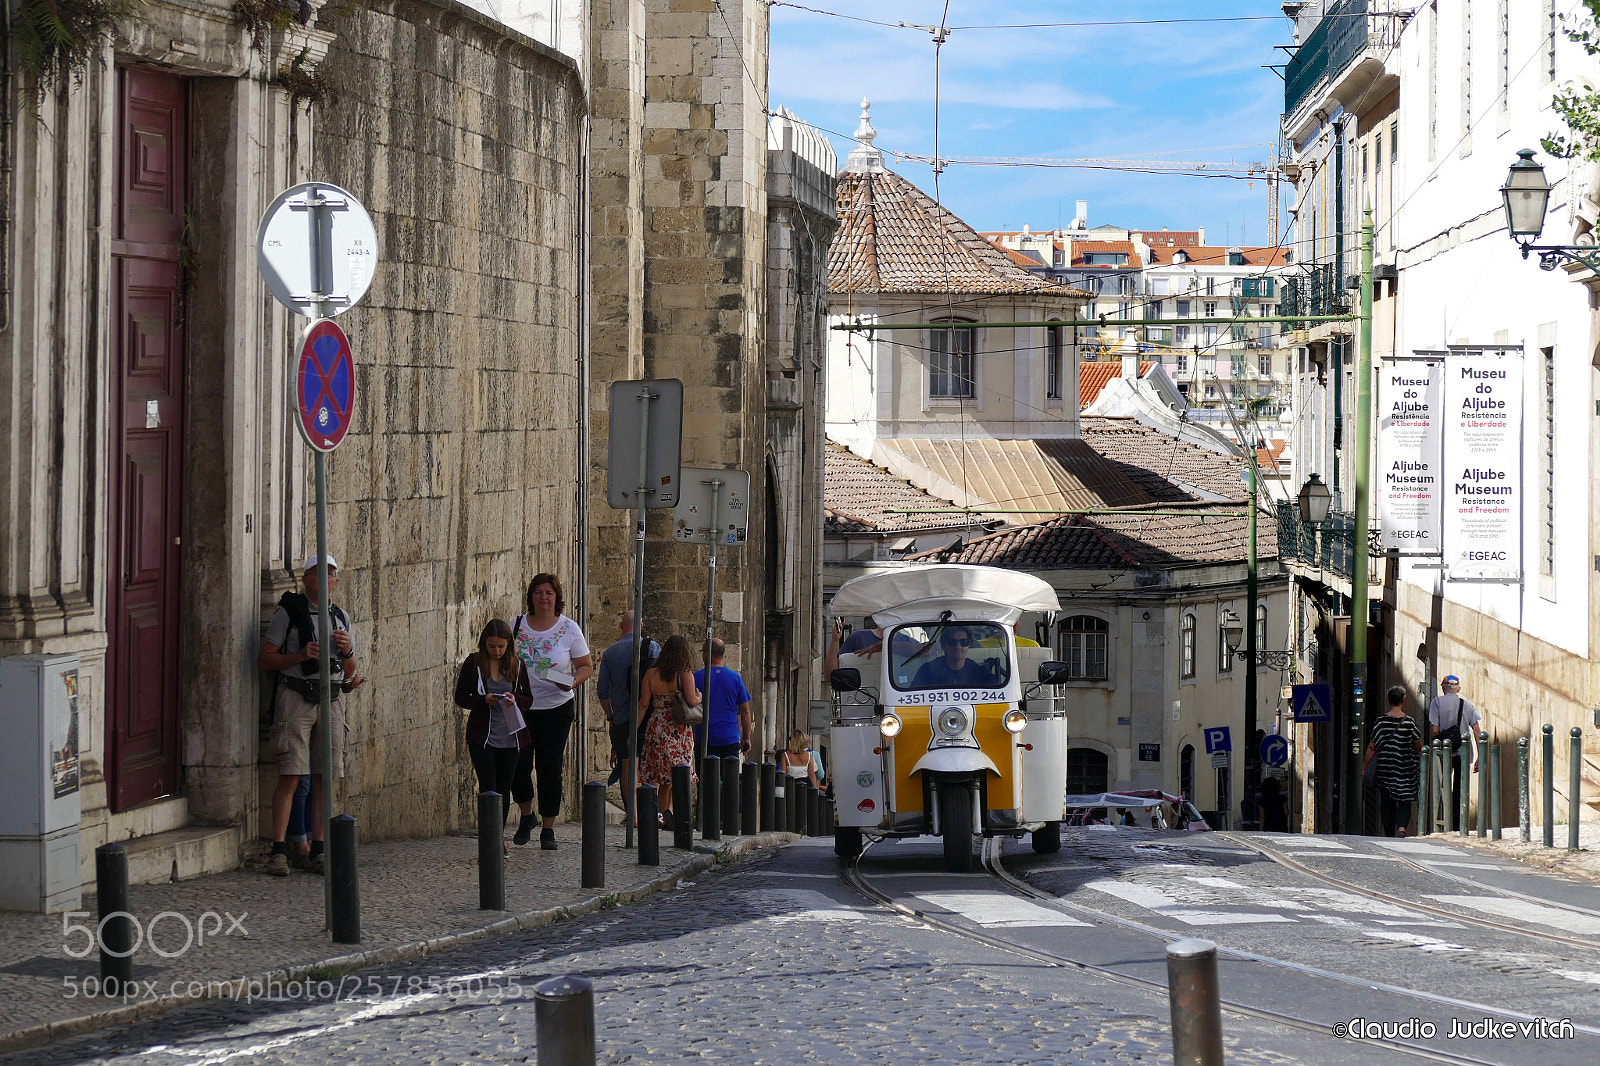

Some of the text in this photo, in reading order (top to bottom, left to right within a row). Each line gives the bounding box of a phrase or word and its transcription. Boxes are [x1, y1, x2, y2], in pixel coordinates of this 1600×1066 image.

[346, 248, 370, 256] 2443-A
[1461, 367, 1506, 379] Museu
[1392, 376, 1430, 386] Museu
[1403, 388, 1418, 399] do
[1475, 382, 1492, 394] do
[1392, 401, 1429, 414] Aljube
[1462, 397, 1506, 412] Aljube
[1461, 411, 1507, 419] Resistência
[1467, 420, 1507, 428] Liberdade
[1392, 460, 1429, 473] Aljube
[1386, 473, 1434, 483] Museum
[1462, 468, 1506, 483] Aljube
[1455, 483, 1512, 495] Museum
[1462, 497, 1506, 505] Resistance
[1397, 530, 1429, 539] EGEAC
[1469, 551, 1507, 561] EGEAC
[898, 691, 1006, 704] +351 931 902 244
[1209, 730, 1225, 750] P
